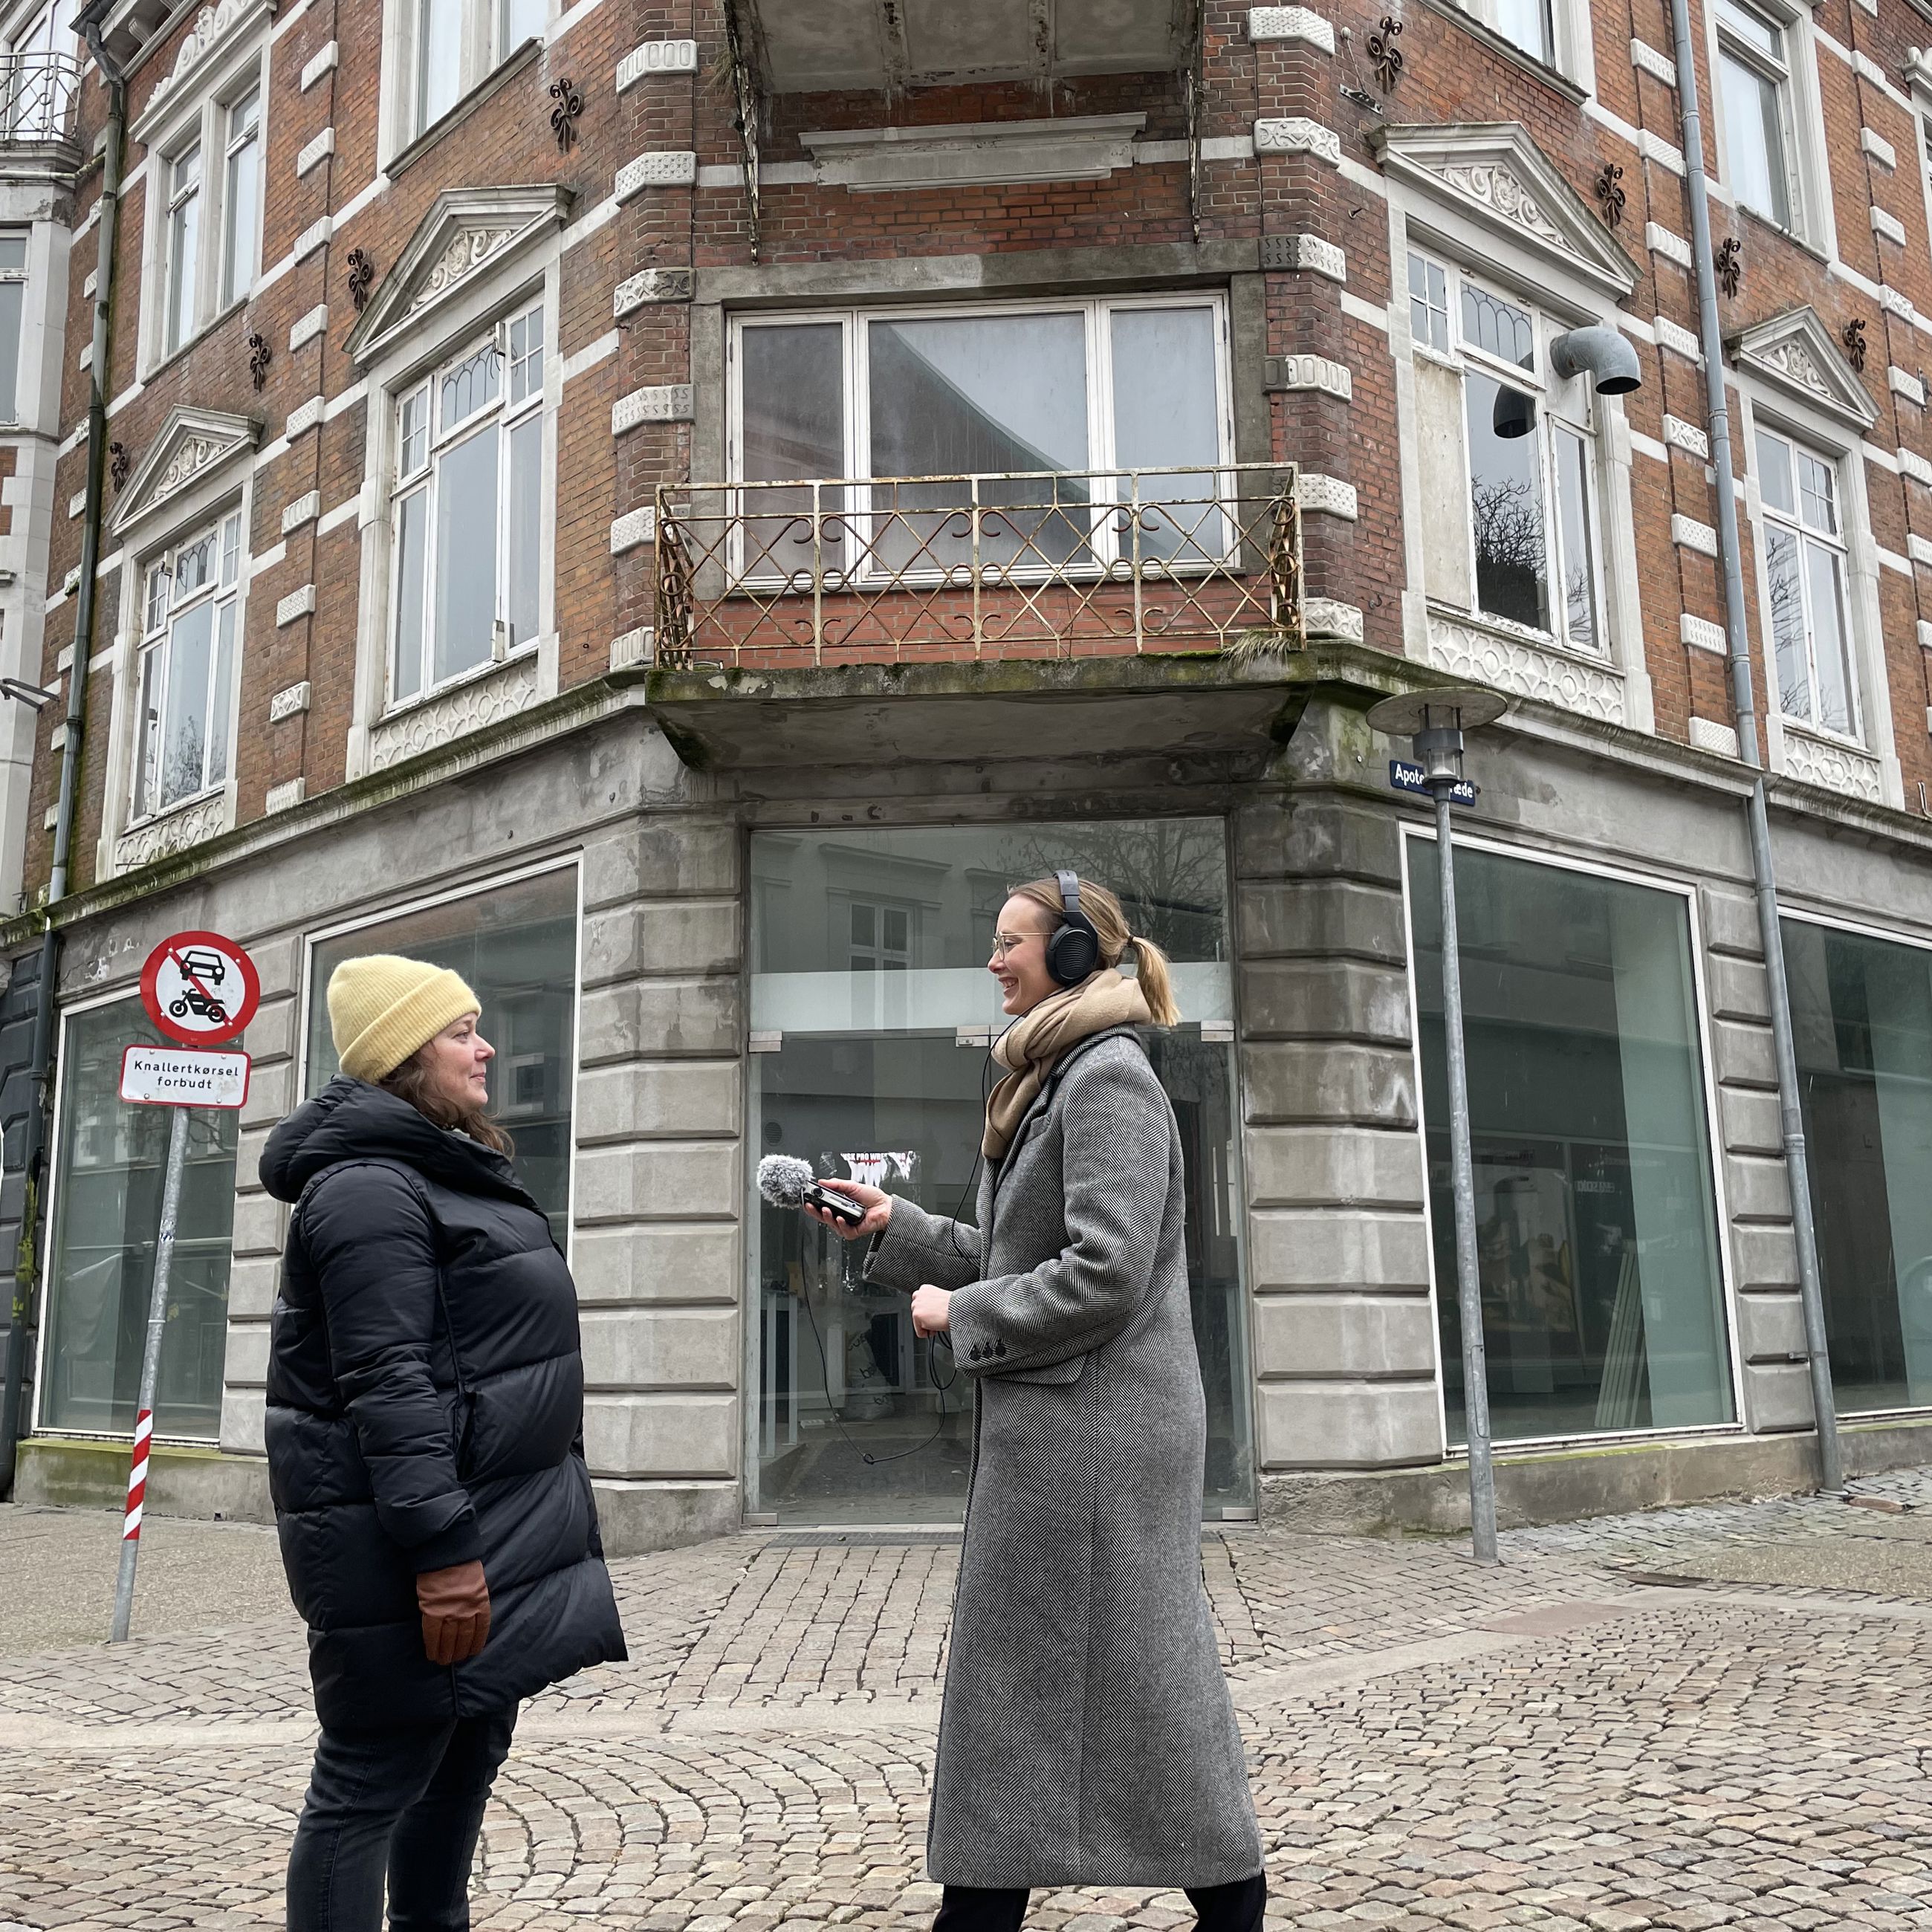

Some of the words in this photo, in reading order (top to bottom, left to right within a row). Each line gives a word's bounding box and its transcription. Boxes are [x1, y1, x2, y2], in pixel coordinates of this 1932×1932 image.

[1395, 763, 1474, 798] Apoteæde
[134, 1060, 239, 1076] Knallertkørsel
[158, 1076, 212, 1089] forbudt
[856, 1153, 869, 1161] PRO
